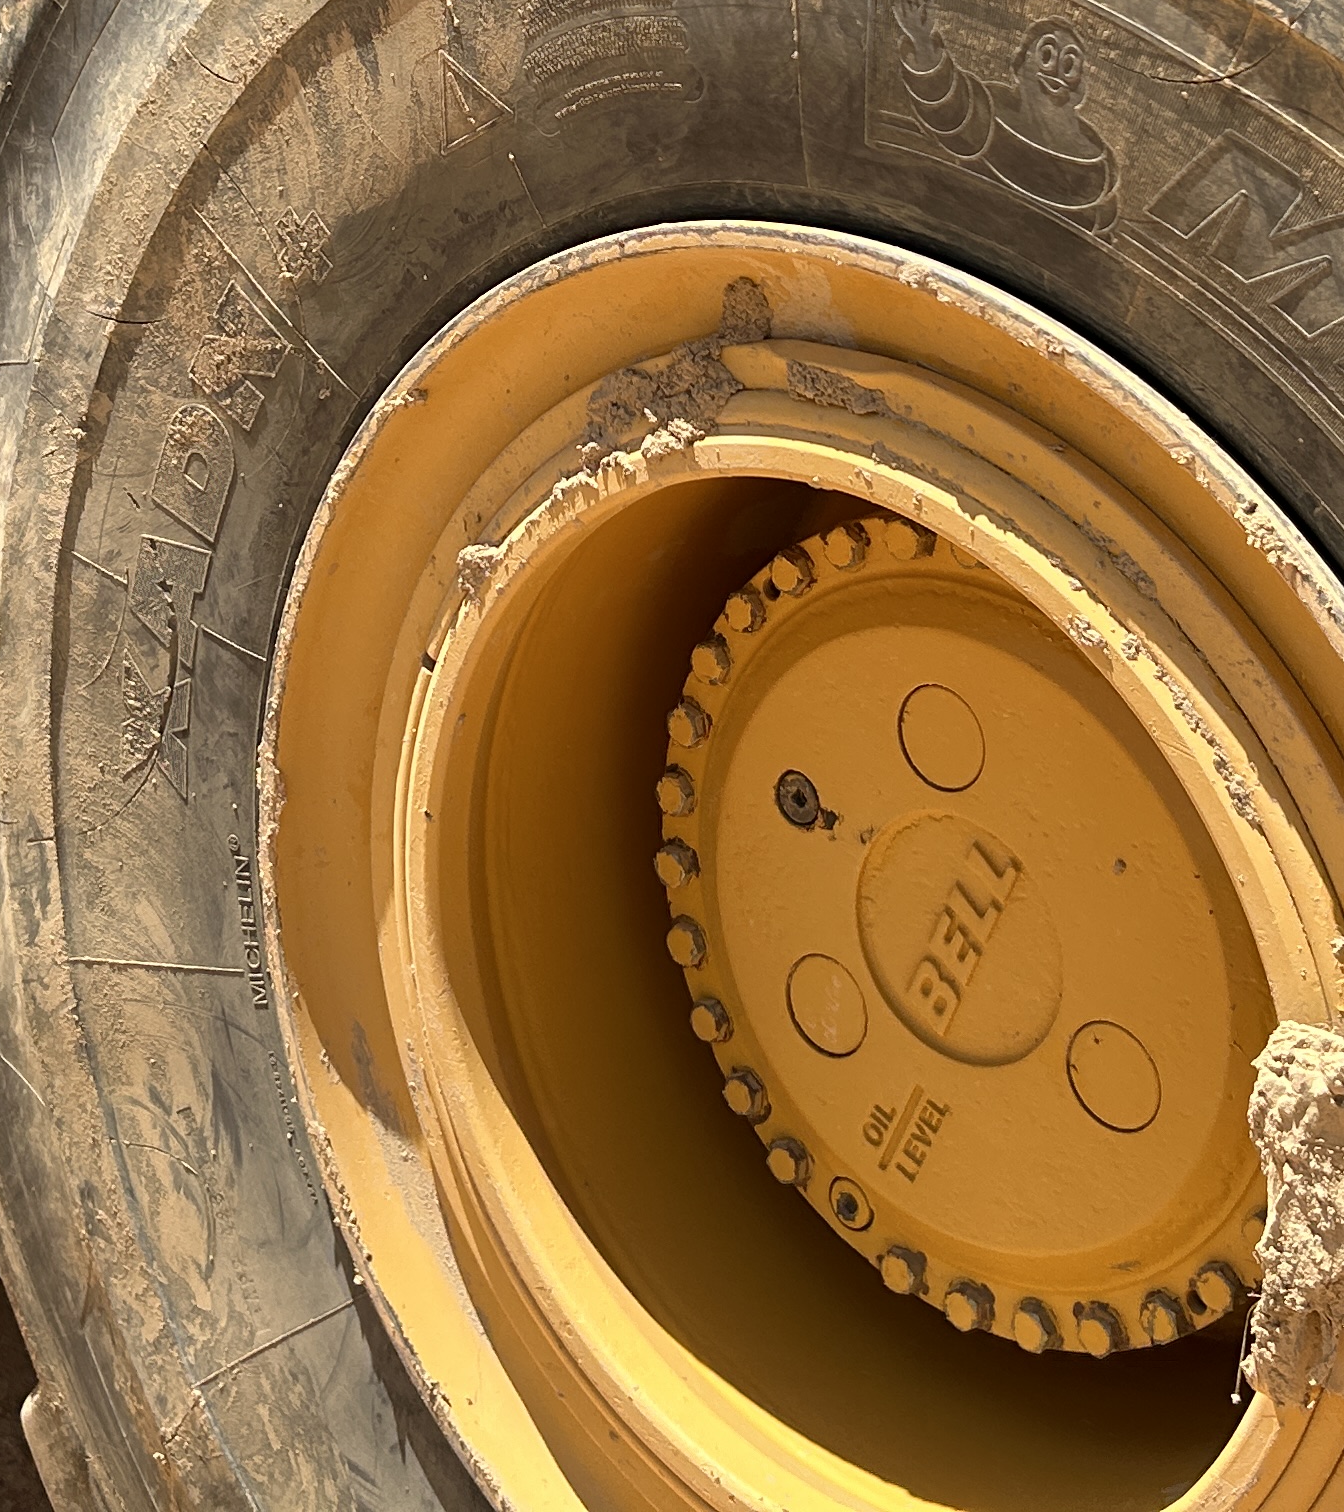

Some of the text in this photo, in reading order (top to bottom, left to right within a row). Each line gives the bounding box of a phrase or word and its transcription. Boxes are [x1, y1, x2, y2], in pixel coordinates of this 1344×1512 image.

[907, 839, 1023, 1038] BELL
[862, 1103, 897, 1148] OIL
[895, 1099, 953, 1184] LEVEL
